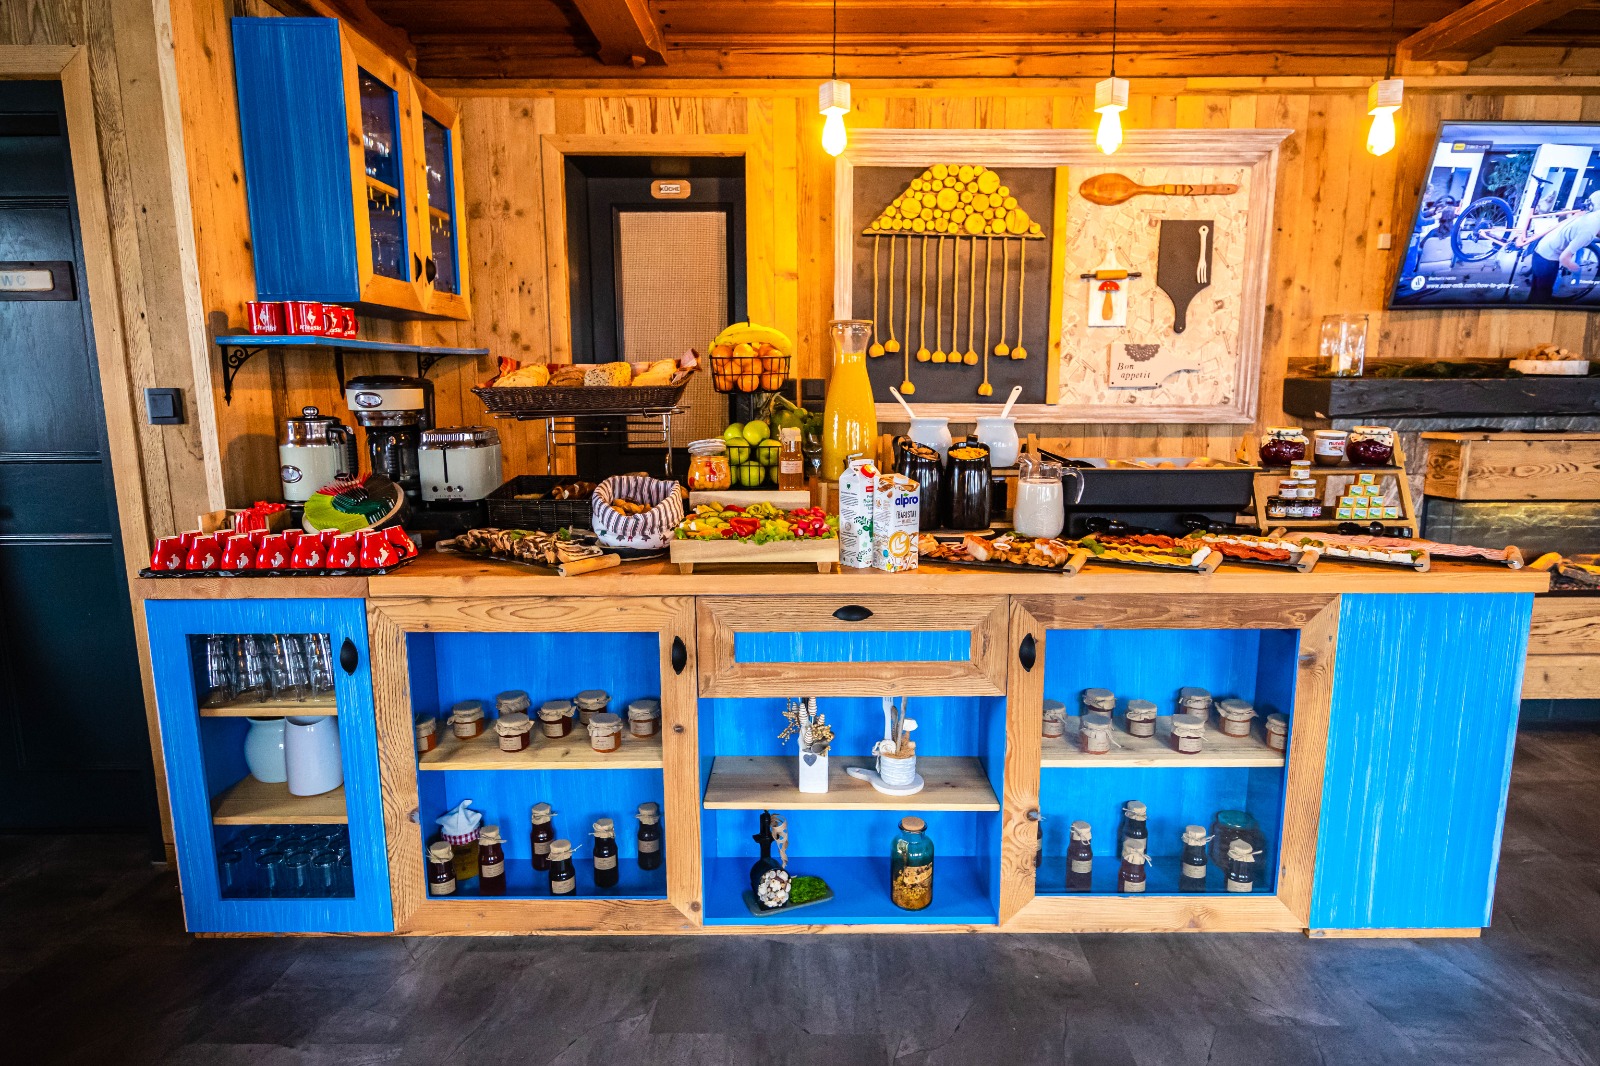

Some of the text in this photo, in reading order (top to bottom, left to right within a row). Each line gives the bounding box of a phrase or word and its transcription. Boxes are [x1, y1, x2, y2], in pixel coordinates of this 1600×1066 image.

[1, 274, 26, 287] WC
[1117, 362, 1134, 370] Bon
[1121, 371, 1151, 380] appetit
[895, 494, 918, 507] alpro
